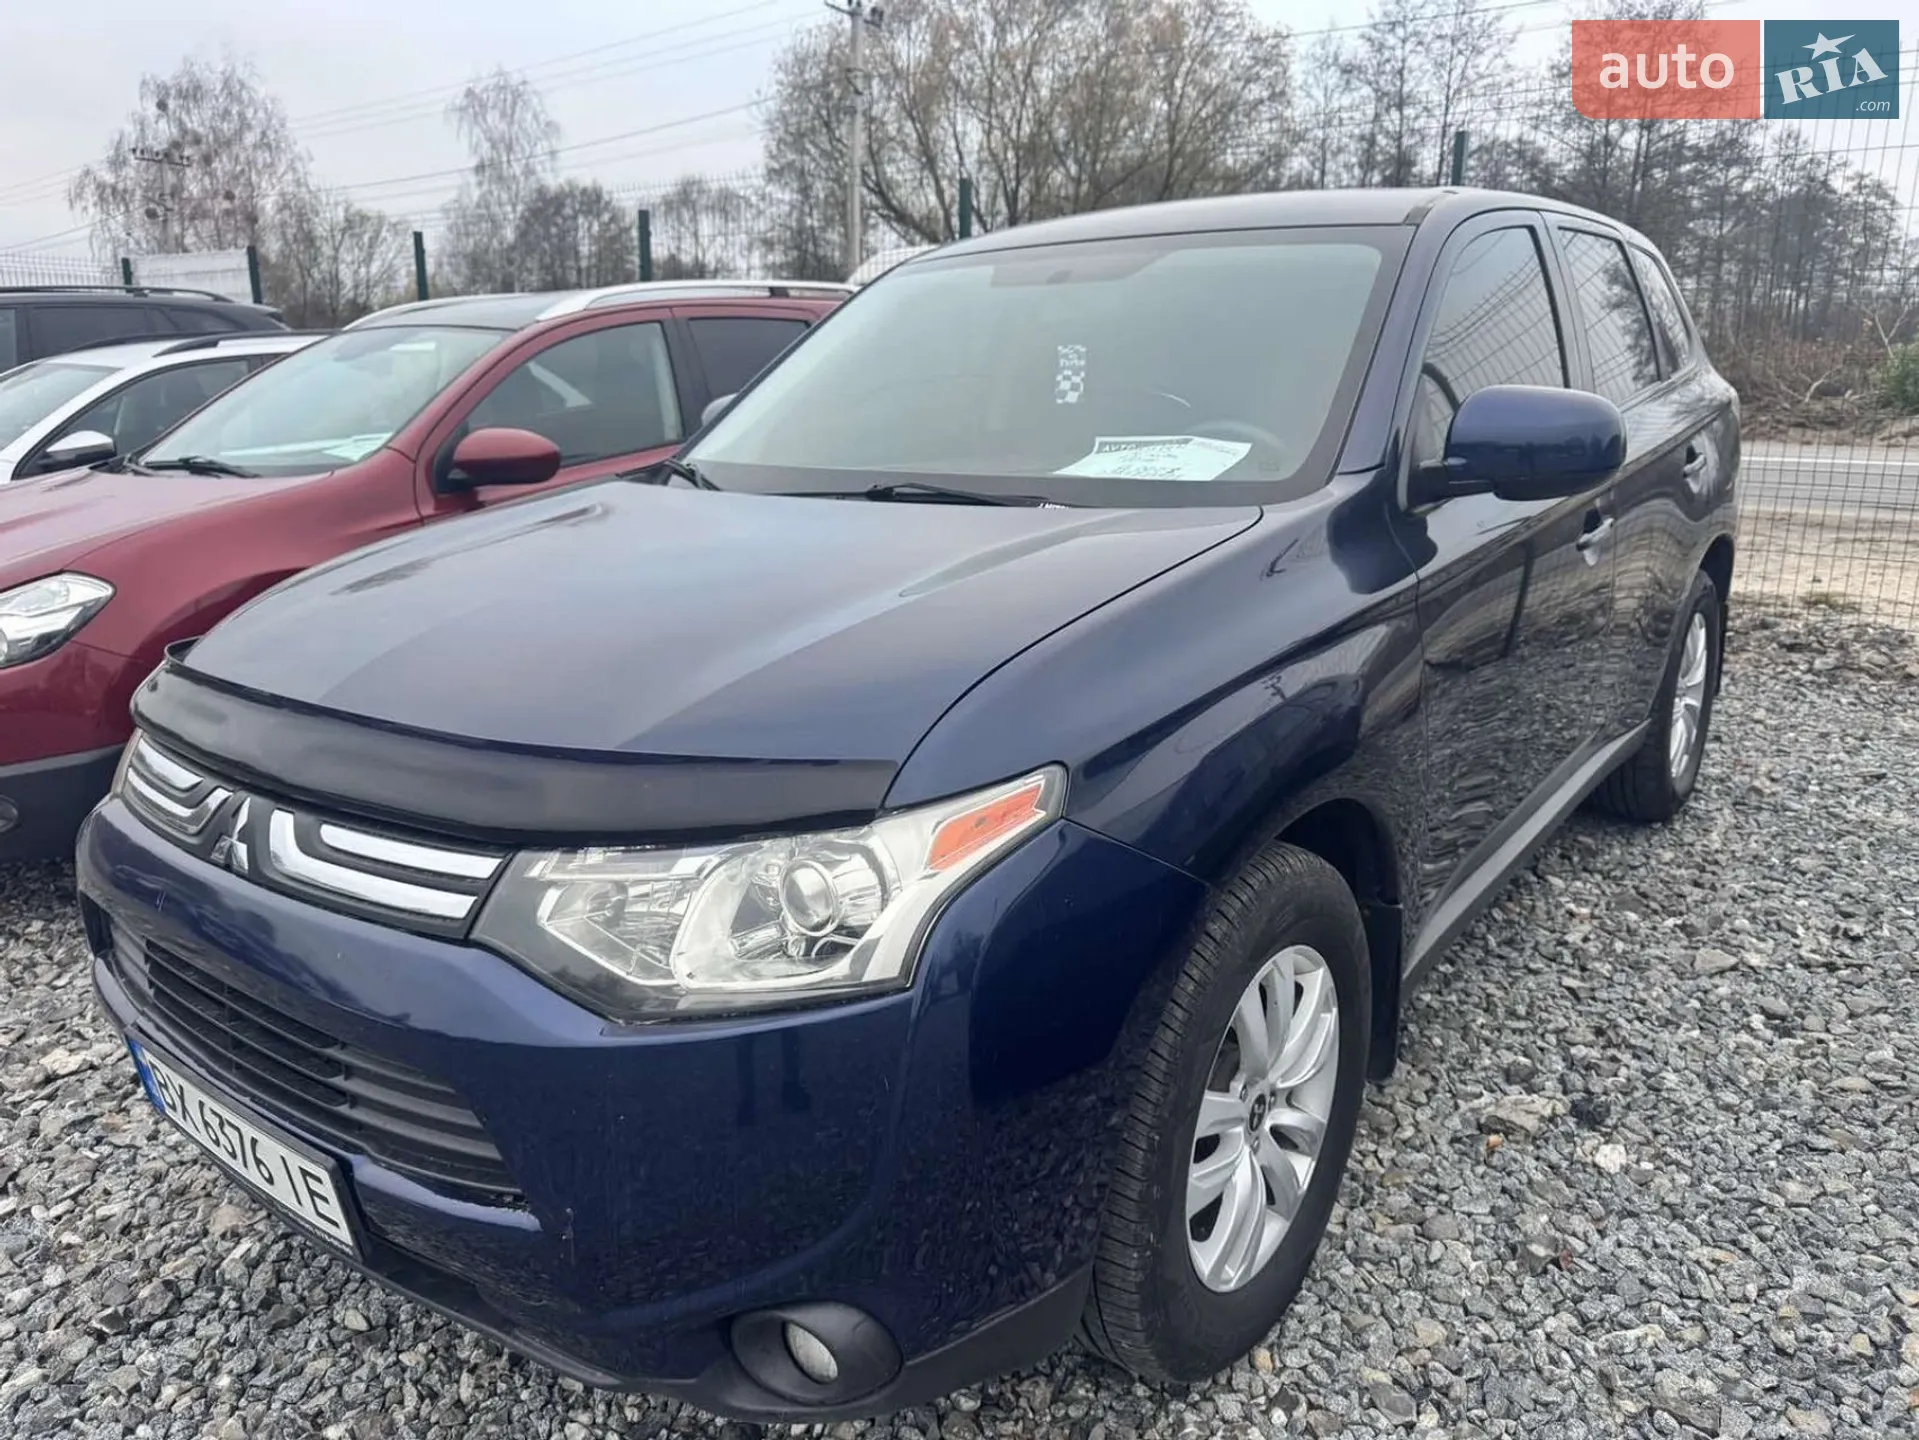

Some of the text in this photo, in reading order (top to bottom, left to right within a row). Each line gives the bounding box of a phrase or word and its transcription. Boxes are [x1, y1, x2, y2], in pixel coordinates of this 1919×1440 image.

[150, 1061, 341, 1229] BX 6376 IE
